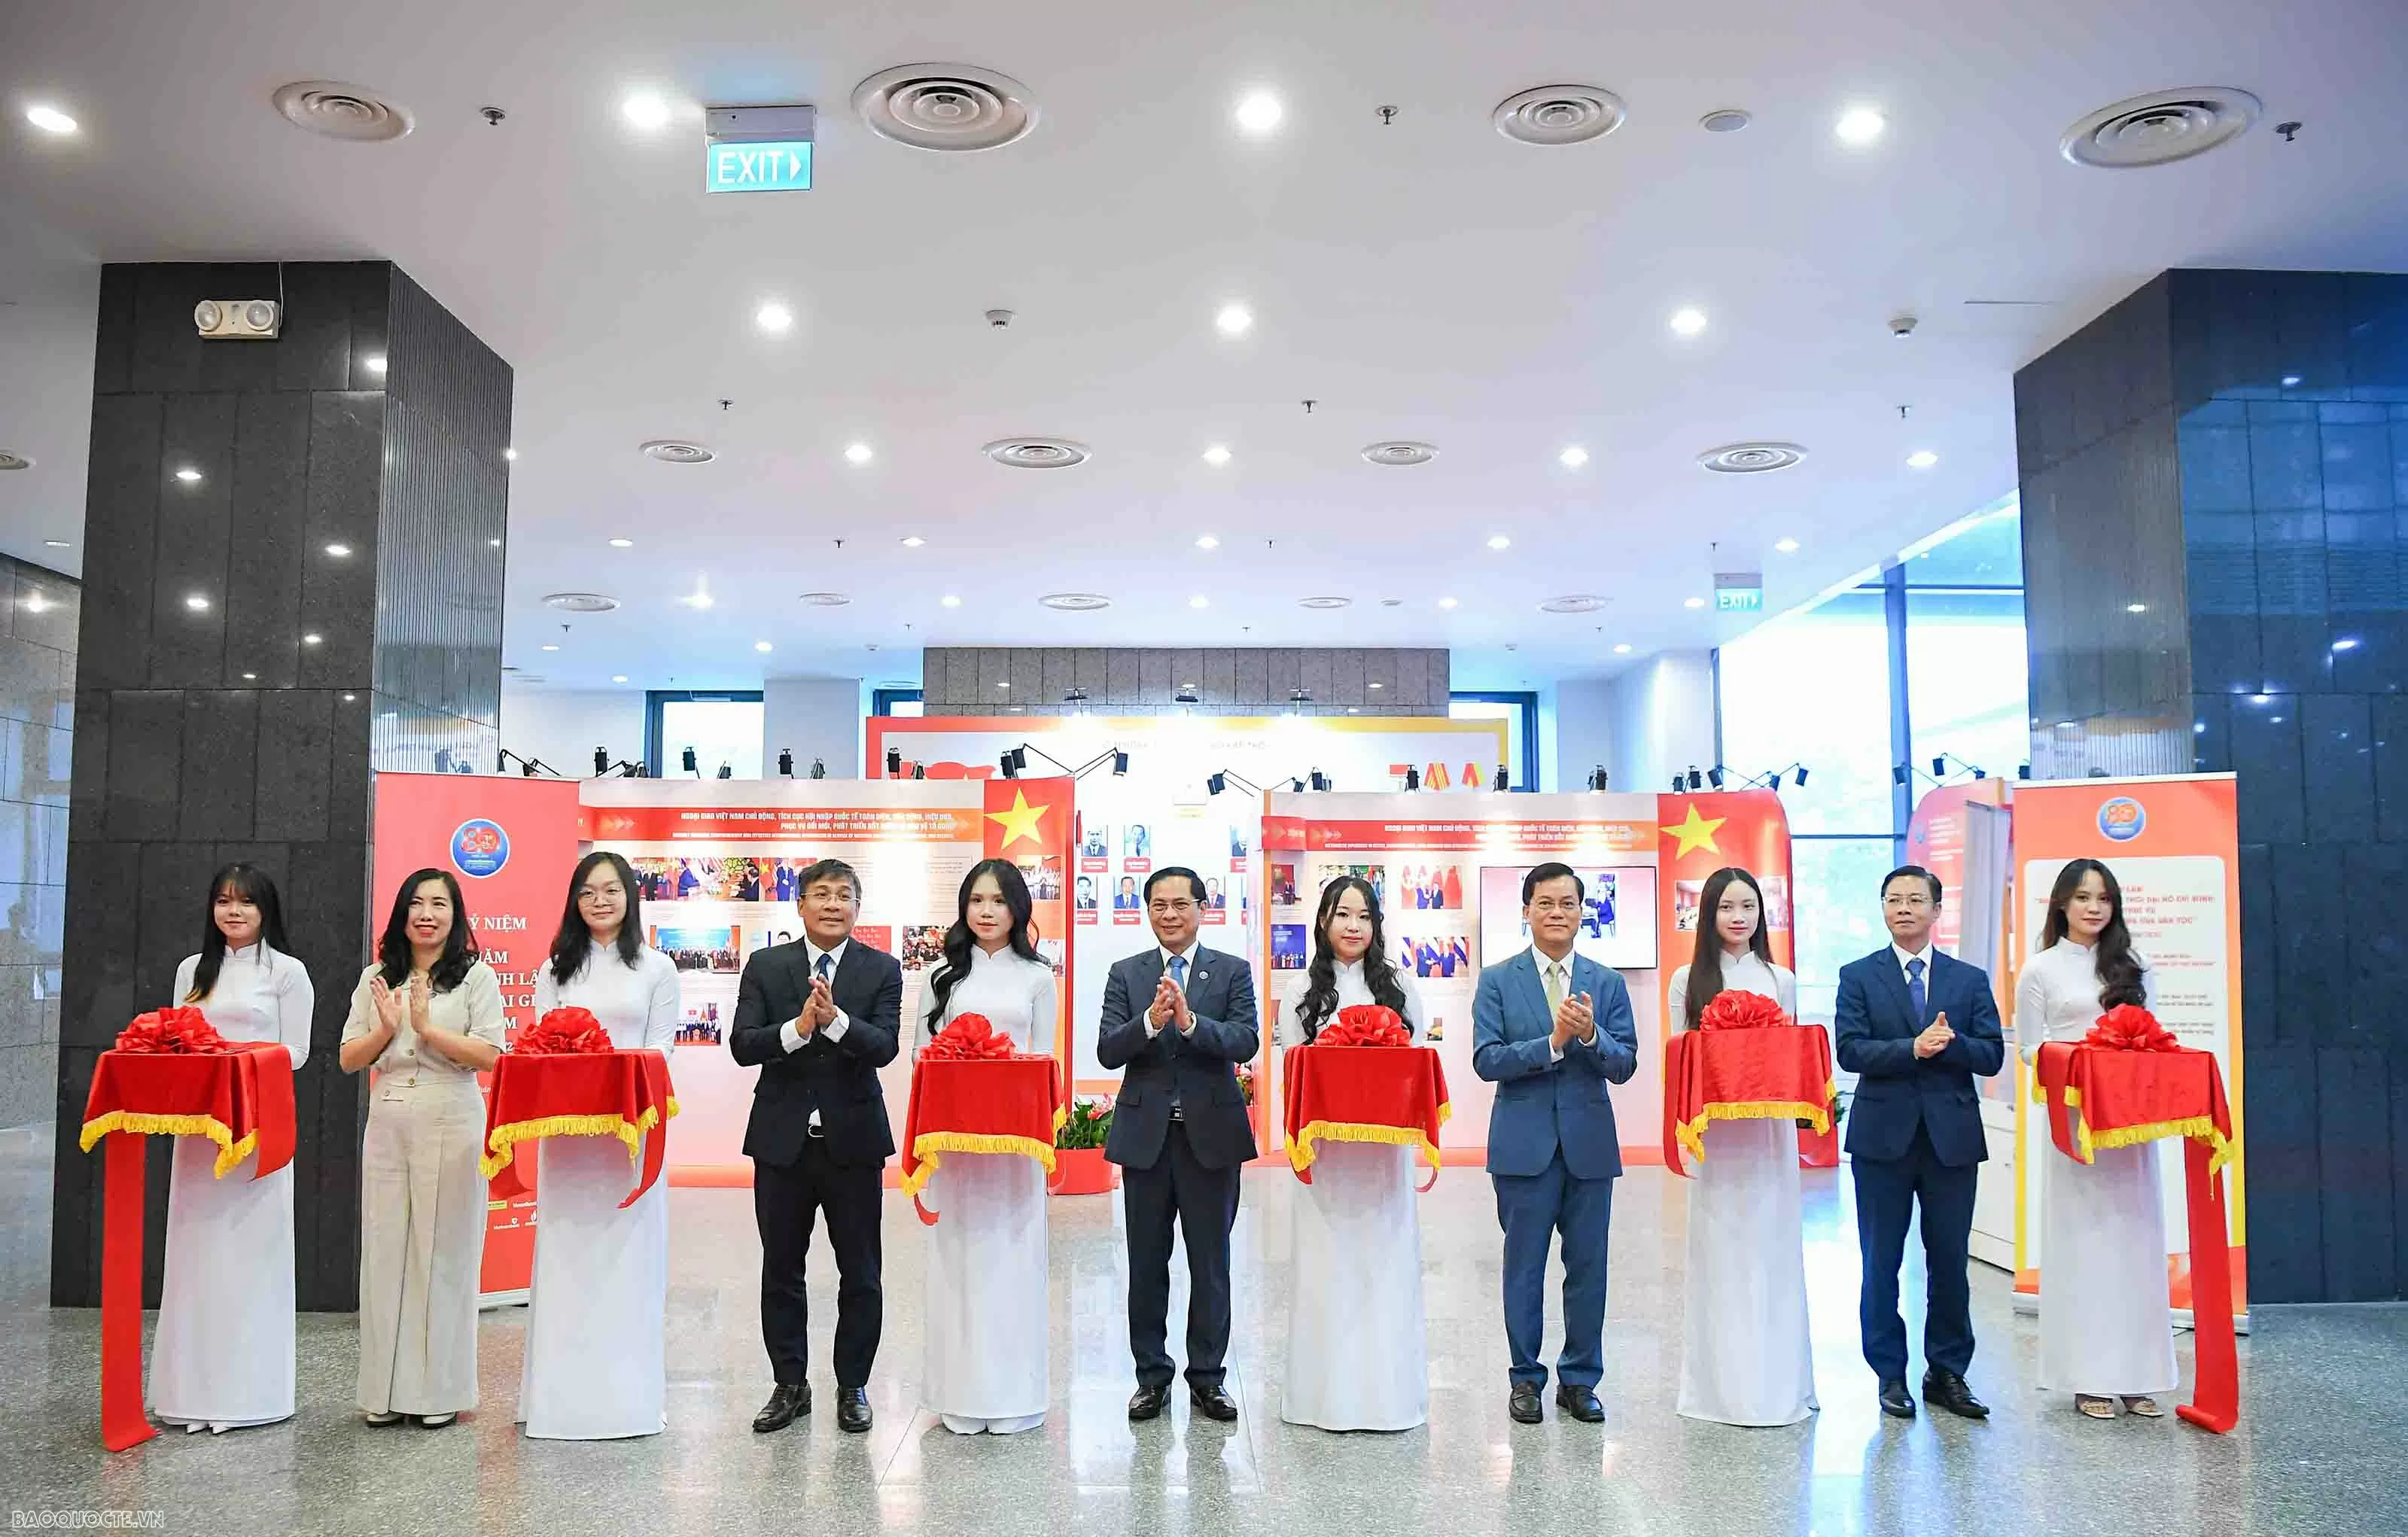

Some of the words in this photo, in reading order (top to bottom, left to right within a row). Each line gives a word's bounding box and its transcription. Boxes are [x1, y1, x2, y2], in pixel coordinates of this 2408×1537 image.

[717, 151, 784, 184] EXIT
[1719, 593, 1749, 609] EXIT
[483, 914, 527, 933] NIỆM
[518, 969, 539, 988] LẬ
